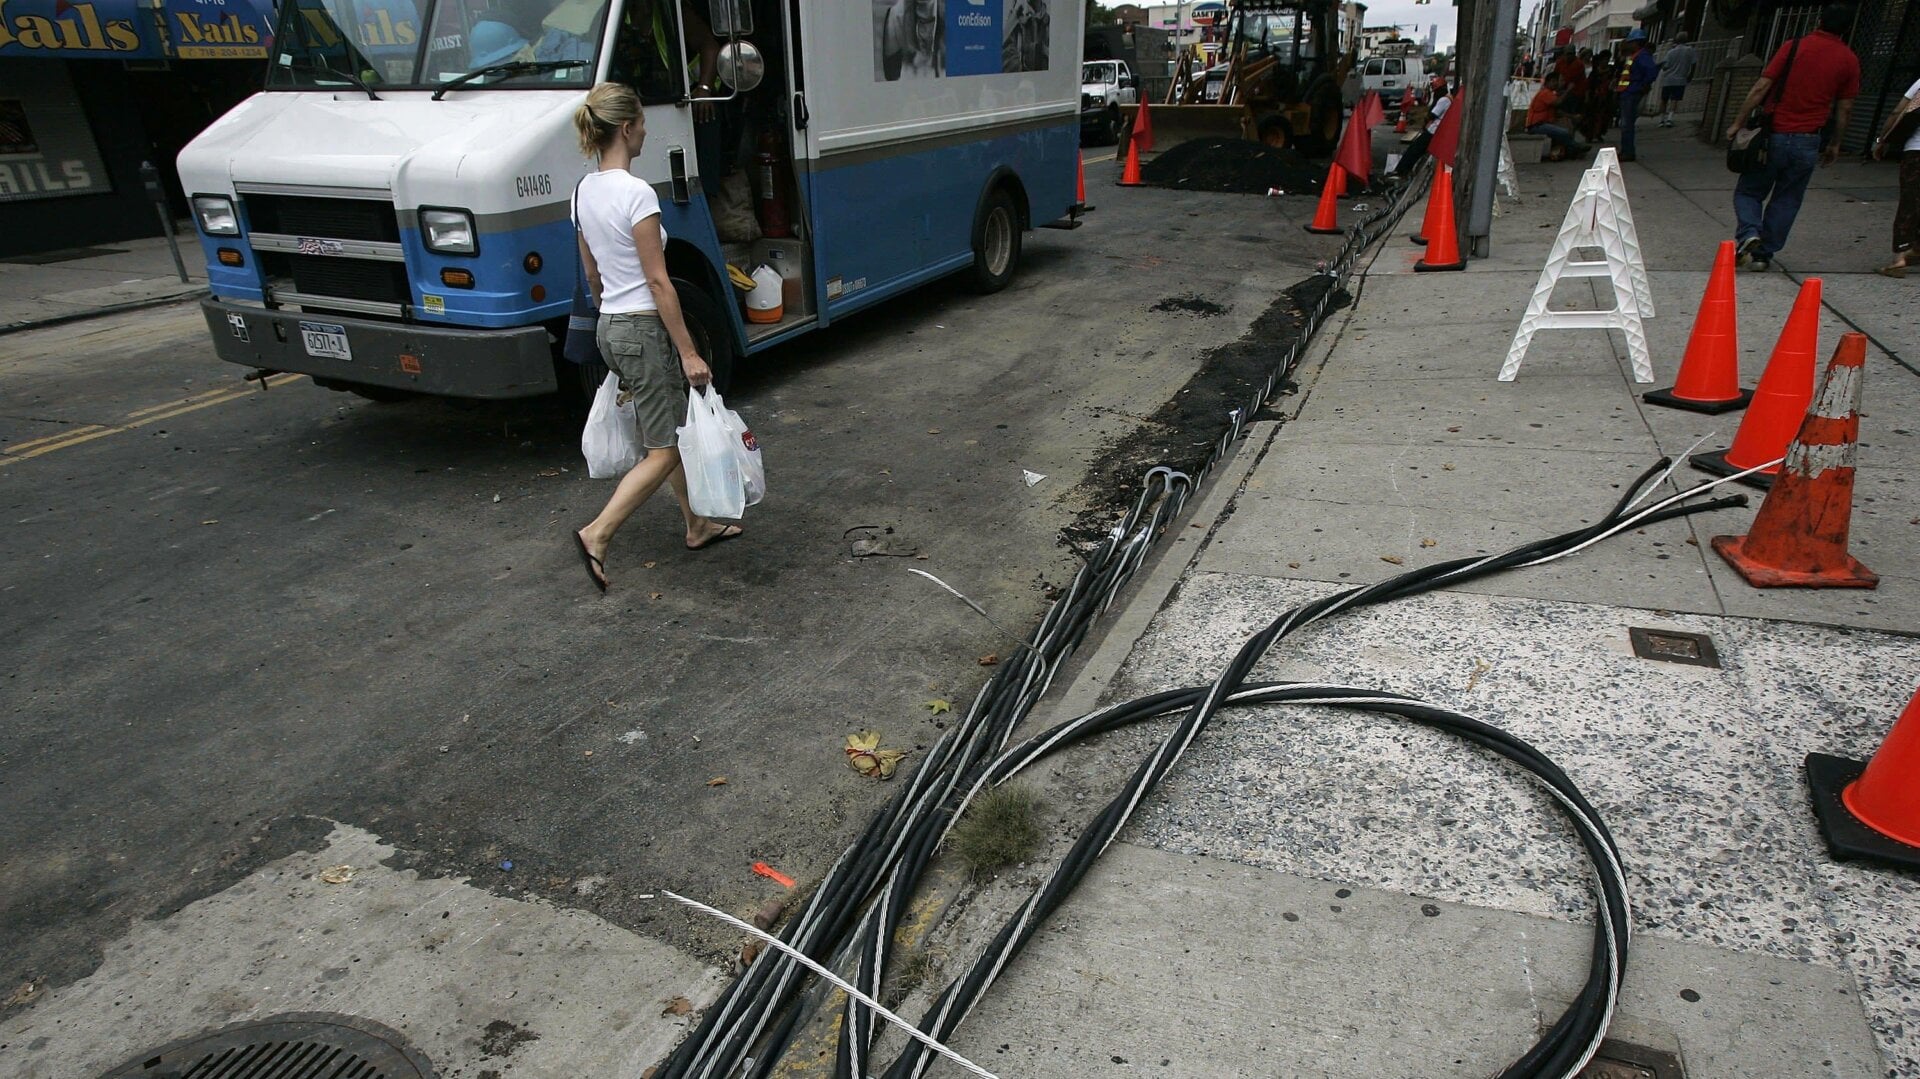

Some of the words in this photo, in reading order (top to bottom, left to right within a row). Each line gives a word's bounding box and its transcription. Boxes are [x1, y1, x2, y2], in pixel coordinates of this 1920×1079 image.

[175, 12, 259, 43] Nails
[958, 12, 992, 27] conEdison
[516, 173, 552, 198] G41486
